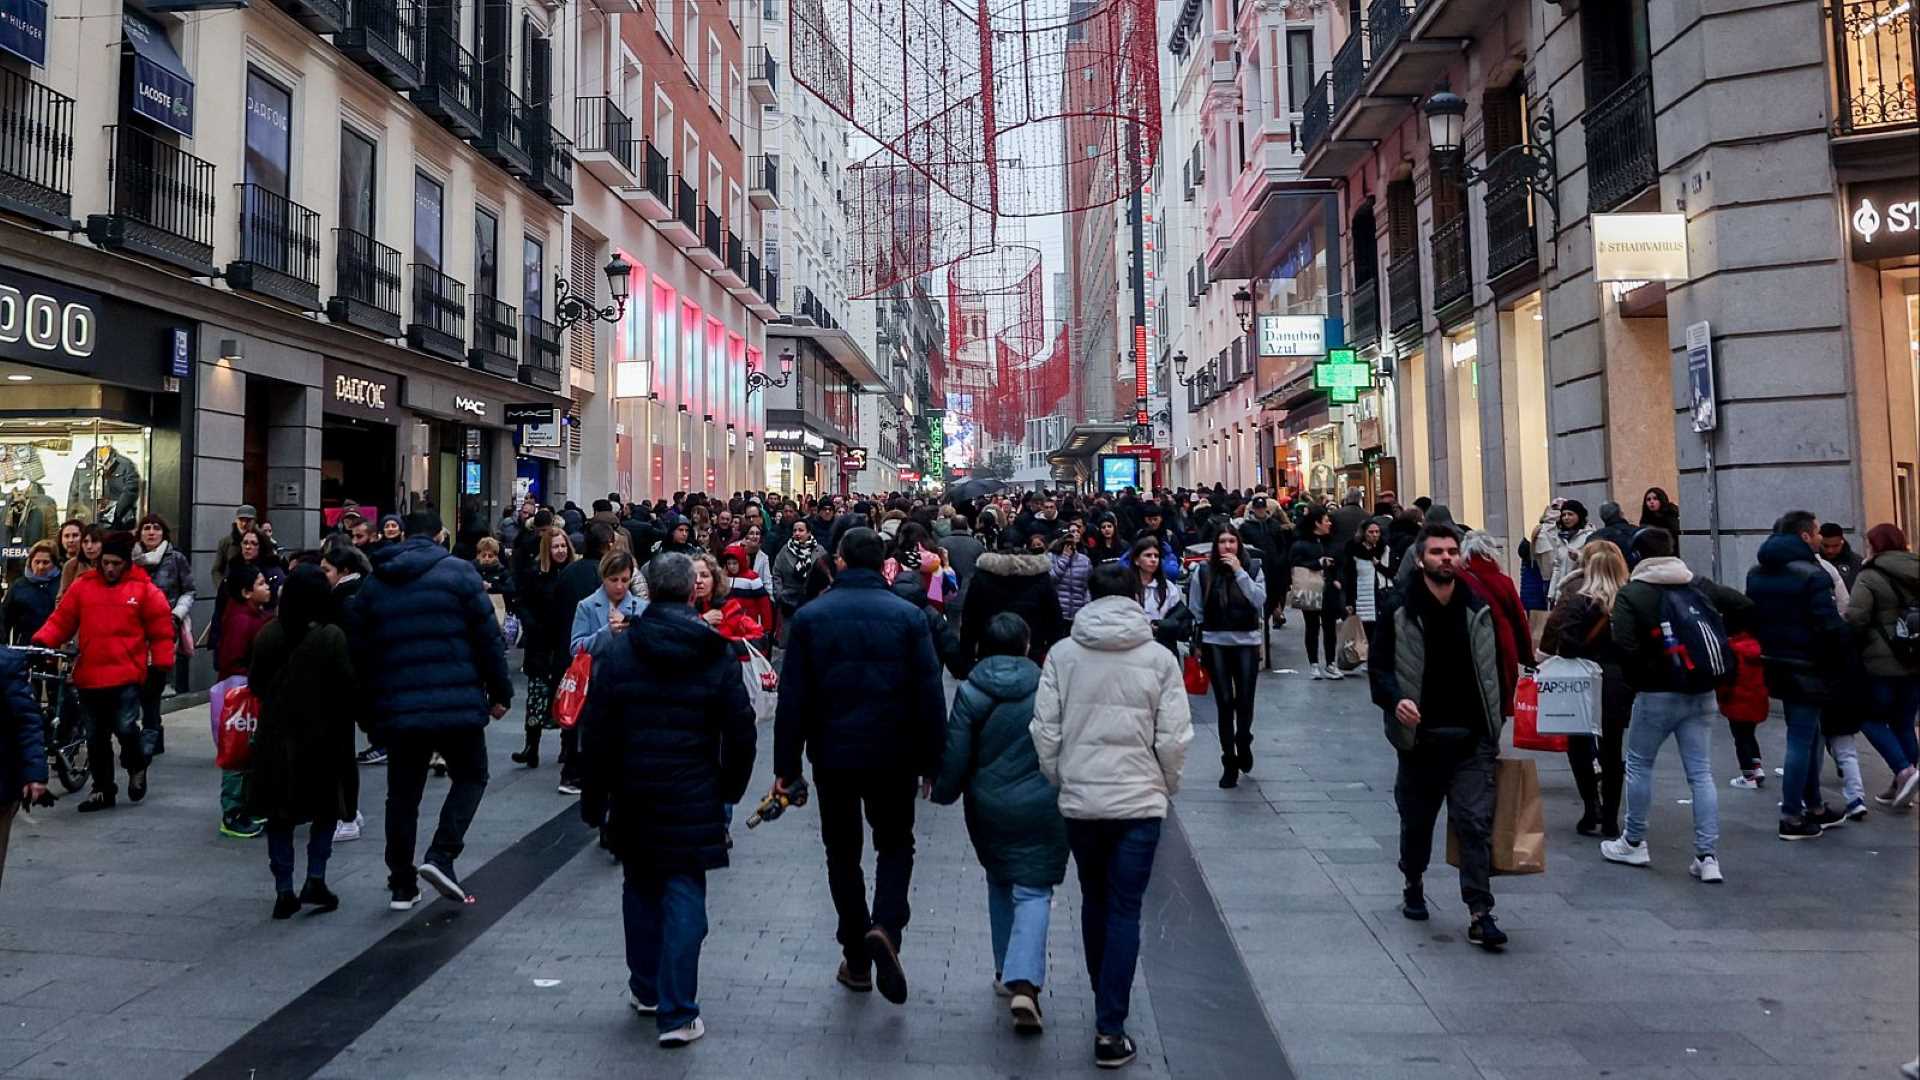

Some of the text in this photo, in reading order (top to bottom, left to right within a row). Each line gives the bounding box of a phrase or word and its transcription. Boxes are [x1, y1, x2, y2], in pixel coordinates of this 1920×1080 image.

[139, 82, 173, 108] LACOSTE
[1607, 241, 1684, 253] STRADIVARIUS
[1264, 318, 1278, 329] El
[1264, 330, 1320, 341] Danubio
[1264, 342, 1297, 354] Azul
[456, 396, 486, 416] MAC
[507, 409, 552, 418] MAC
